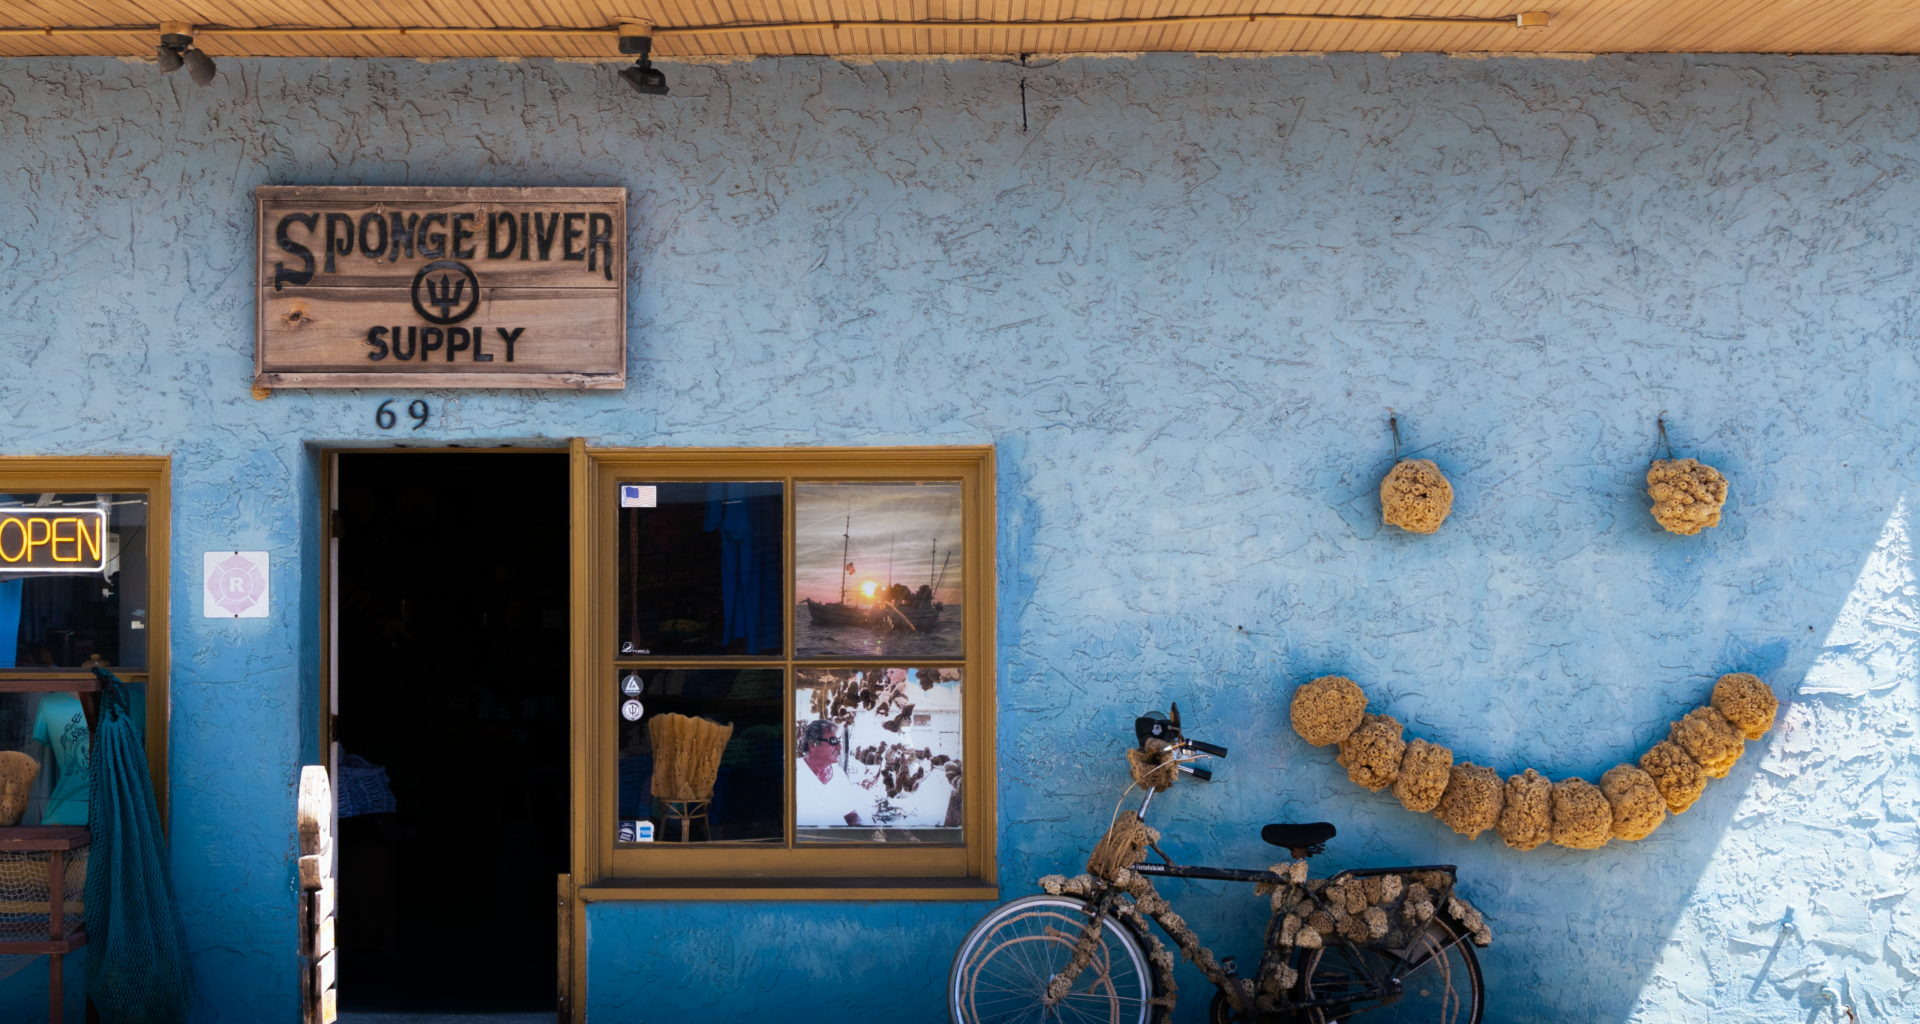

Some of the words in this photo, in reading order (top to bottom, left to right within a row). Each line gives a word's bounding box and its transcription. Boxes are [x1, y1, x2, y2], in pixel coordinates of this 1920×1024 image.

[274, 211, 477, 293] SPONGE
[487, 211, 613, 281] DIVER
[367, 325, 526, 362] SUPPLY
[0, 517, 101, 563] OPEN
[229, 576, 245, 593] R
